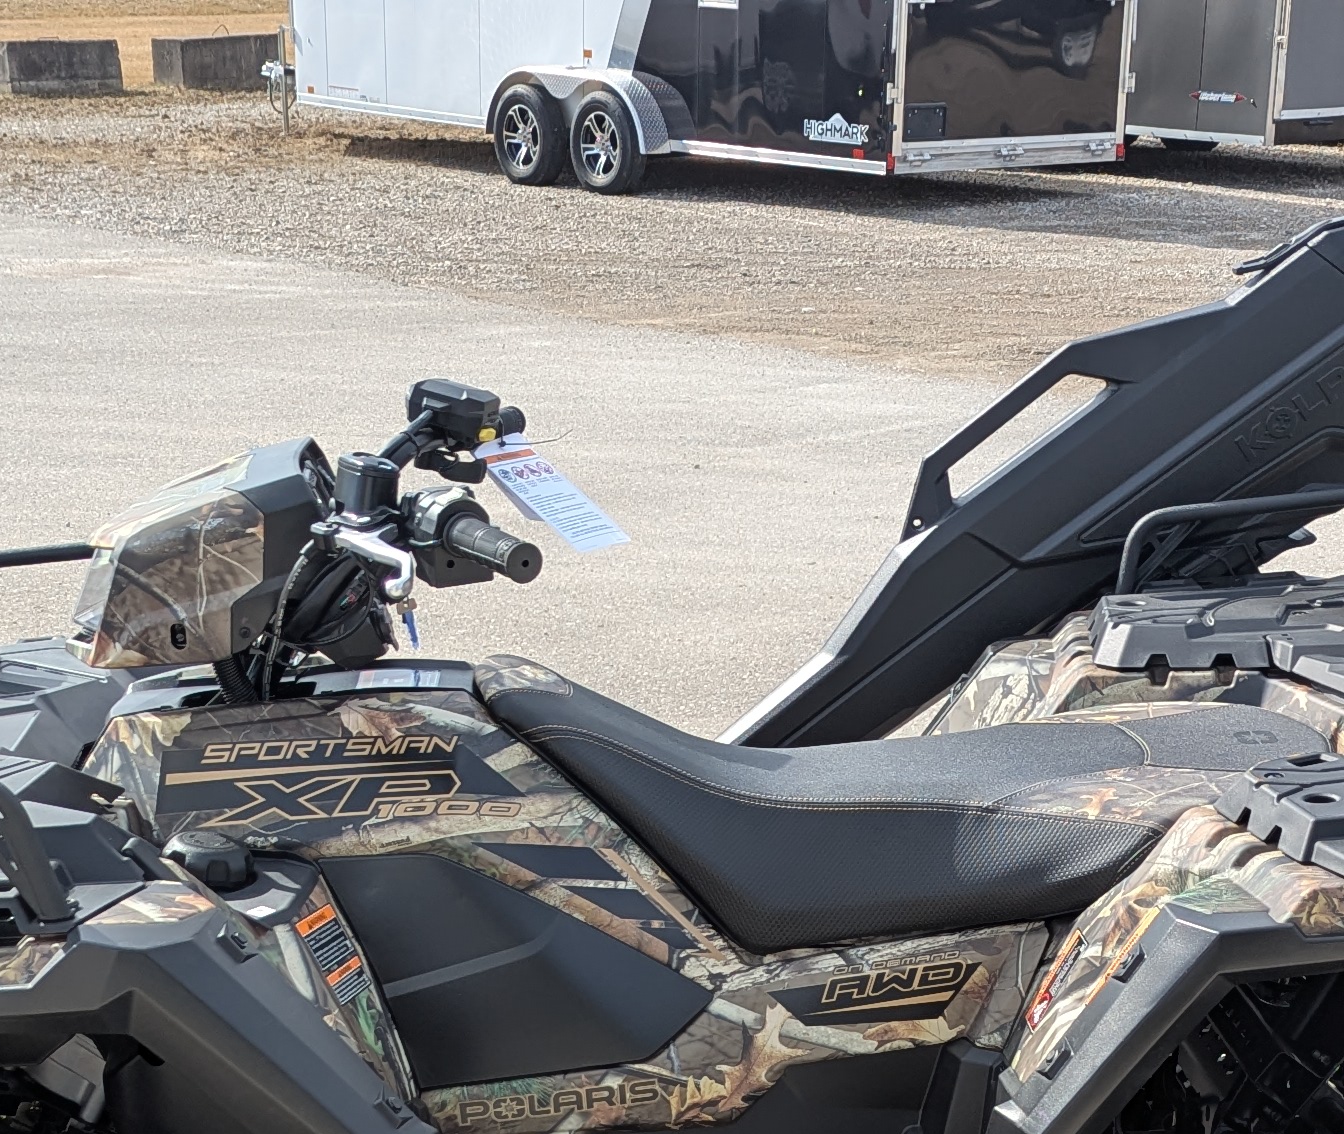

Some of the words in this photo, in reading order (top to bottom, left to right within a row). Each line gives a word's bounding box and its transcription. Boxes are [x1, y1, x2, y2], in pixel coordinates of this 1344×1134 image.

[804, 119, 870, 142] HIGHMARK
[200, 735, 459, 765] SPORTSMAN
[196, 769, 462, 830] XP
[375, 799, 523, 820] 1000
[821, 958, 968, 1004] AWD
[457, 1078, 661, 1128] POLARIS
